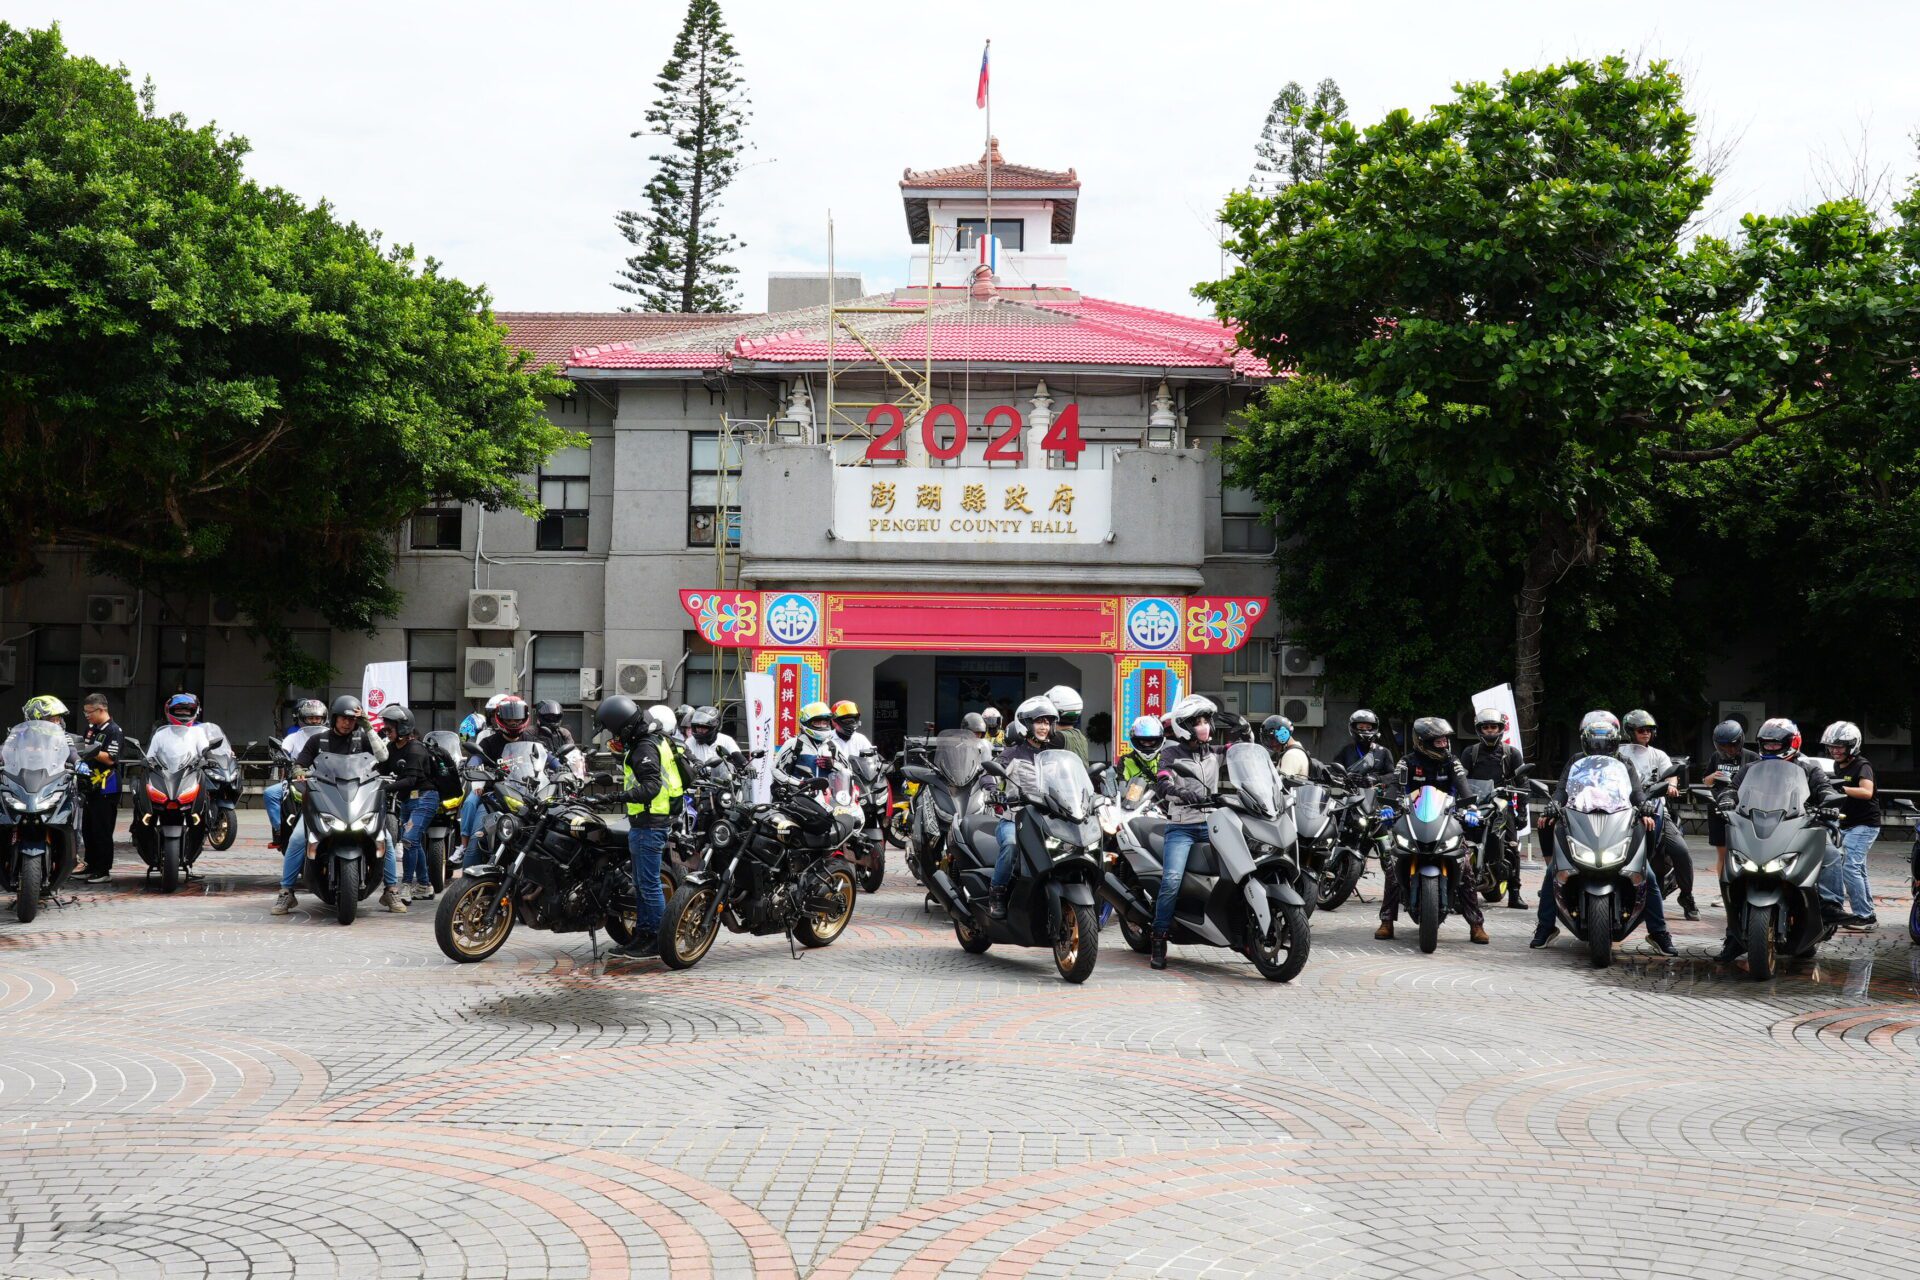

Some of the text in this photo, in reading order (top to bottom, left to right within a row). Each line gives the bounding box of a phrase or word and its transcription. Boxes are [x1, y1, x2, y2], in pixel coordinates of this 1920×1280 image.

[865, 403, 1086, 462] 2024
[870, 480, 1076, 515] 澎湖縣政府
[869, 519, 1077, 534] PENGHU COUNTY HALL
[781, 668, 796, 740] 齊拼未來
[1146, 674, 1161, 719] 共顧
